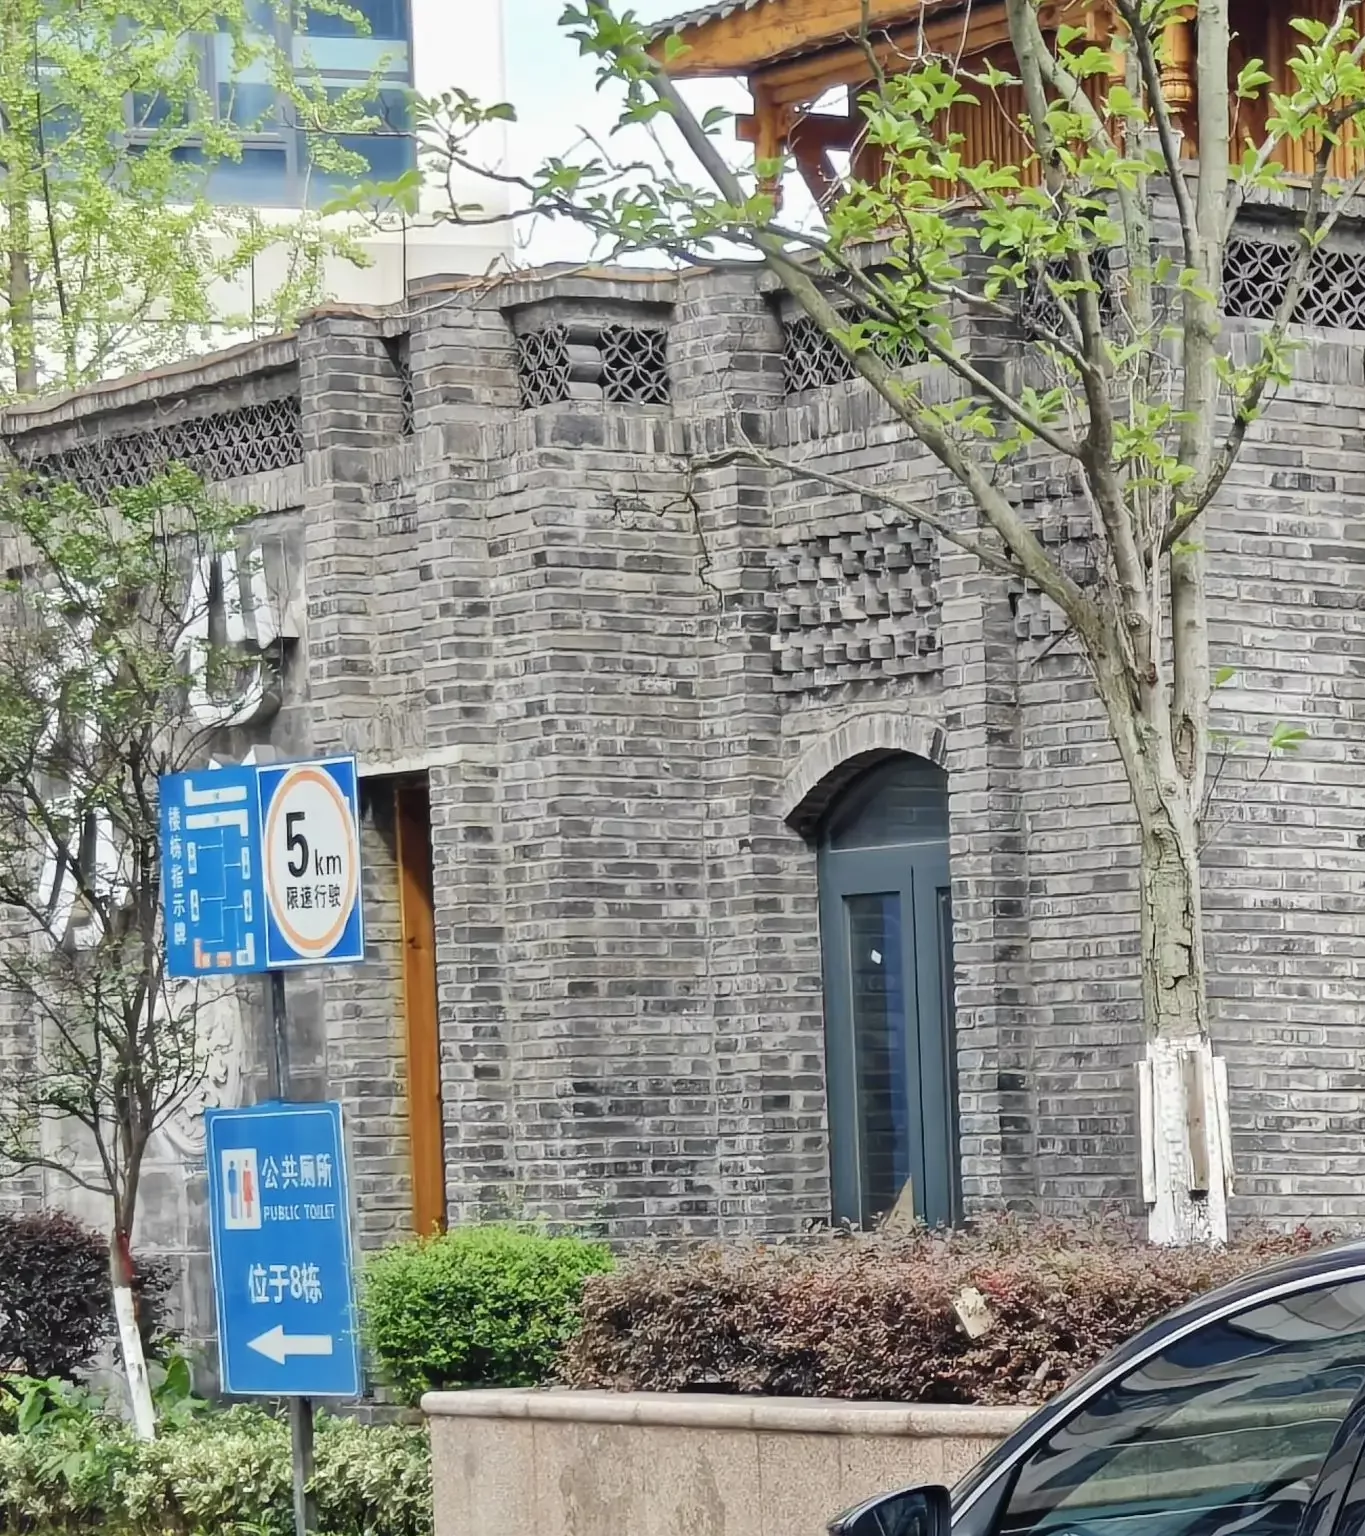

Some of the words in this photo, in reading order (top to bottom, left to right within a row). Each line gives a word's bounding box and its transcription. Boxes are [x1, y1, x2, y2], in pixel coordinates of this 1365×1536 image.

[285, 811, 309, 878] 5
[315, 848, 342, 876] km
[286, 884, 341, 911] 限速行驶
[262, 1152, 333, 1189] 公共厕所
[263, 1205, 300, 1221] PUBLIC
[304, 1203, 335, 1220] TOILET
[248, 1262, 323, 1303] 位于8栋
